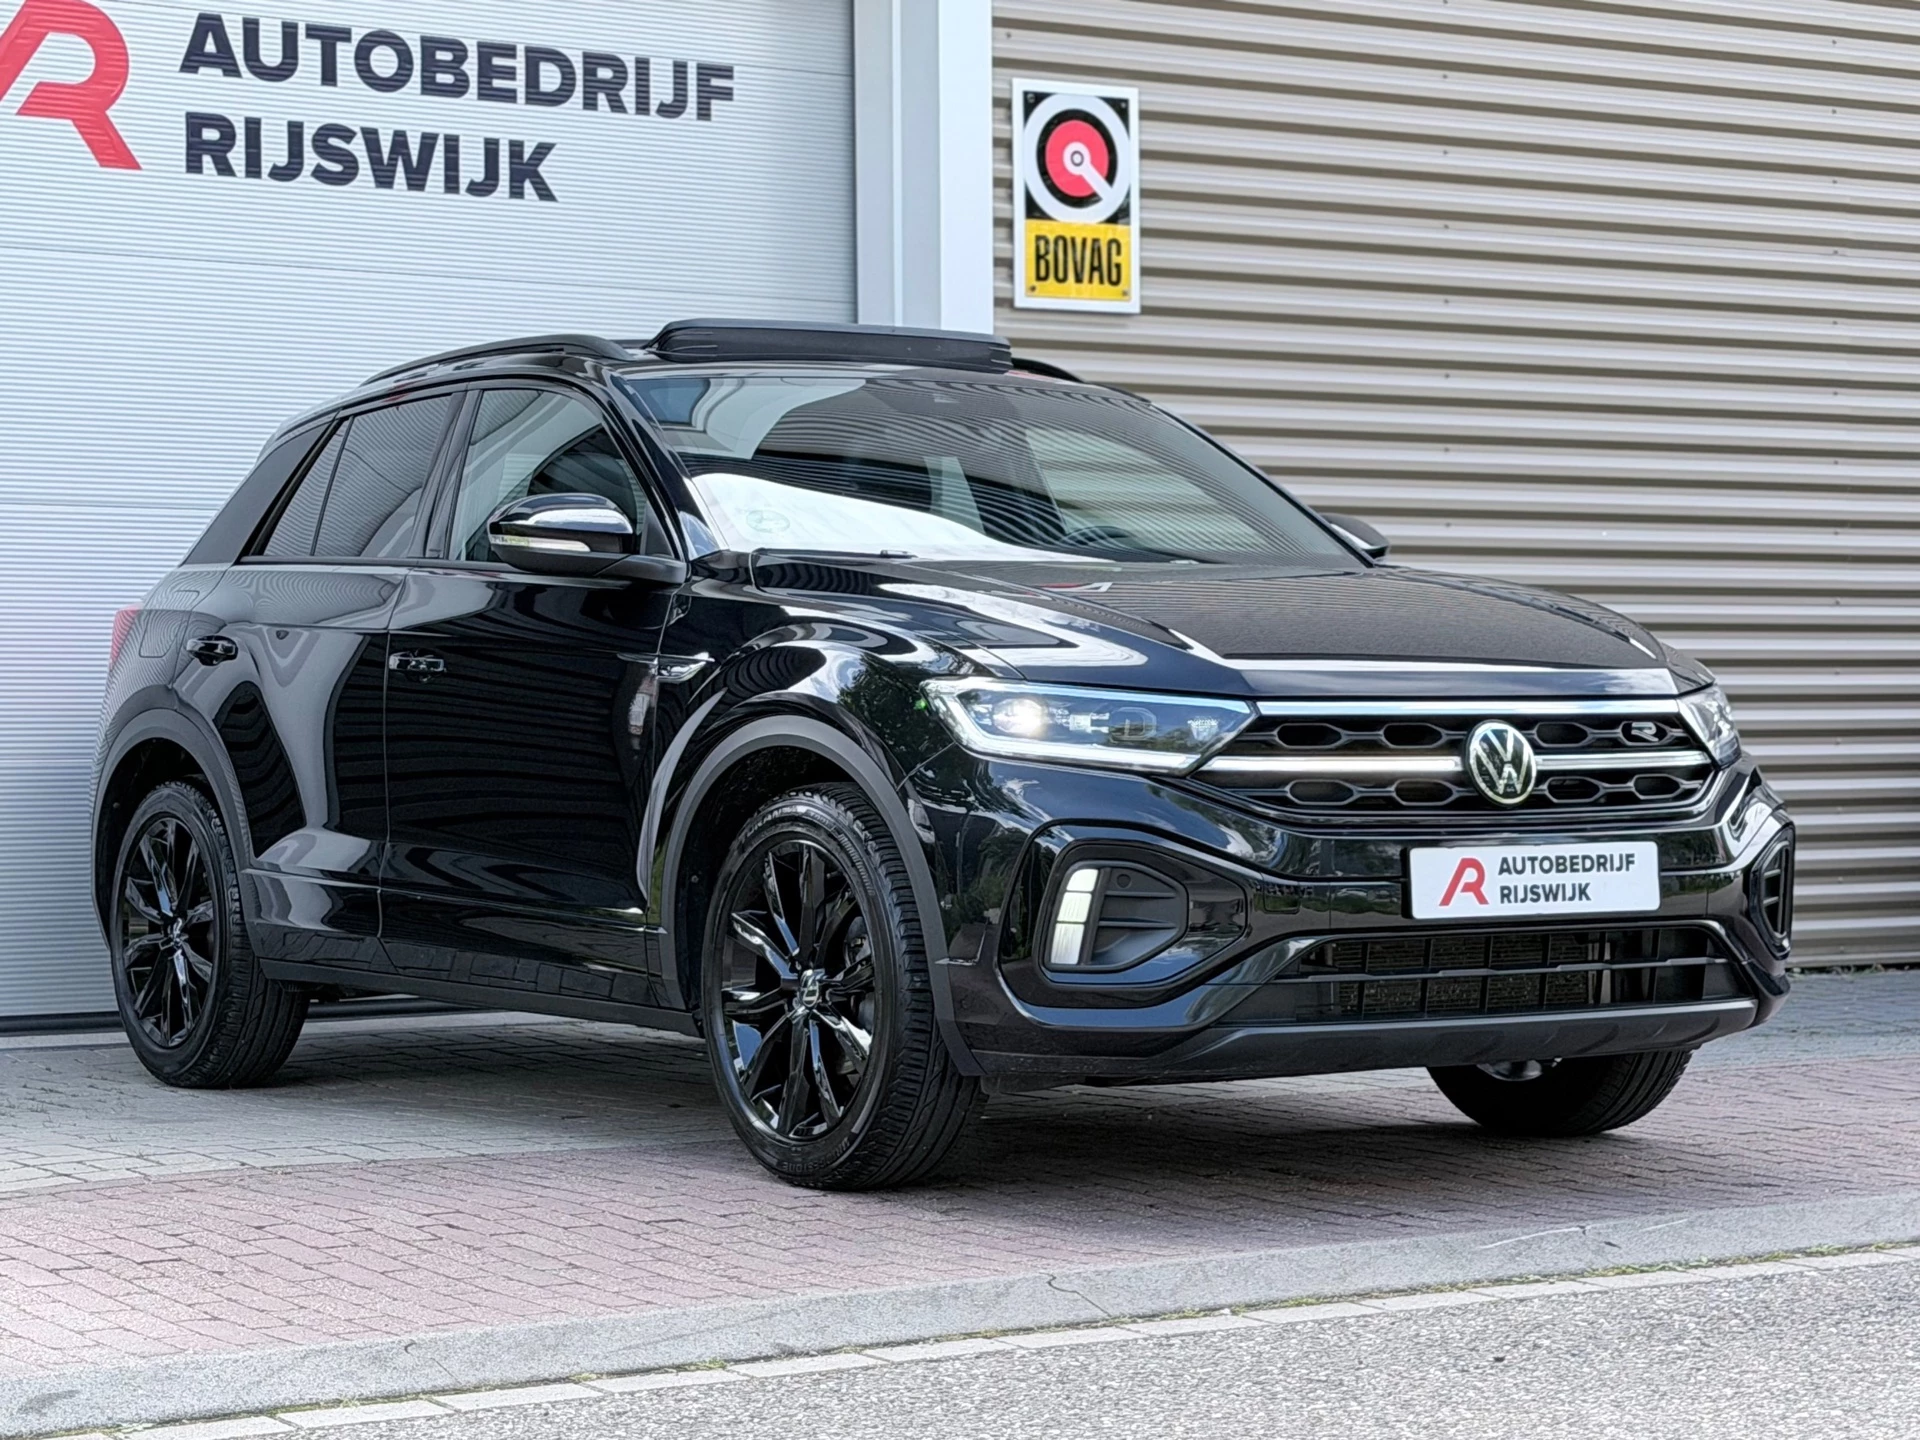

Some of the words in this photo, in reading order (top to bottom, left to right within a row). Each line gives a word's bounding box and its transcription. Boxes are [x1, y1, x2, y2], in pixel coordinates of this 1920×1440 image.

[179, 13, 735, 122] AUTOBEDRIJF
[185, 112, 559, 202] RIJSWIJK
[1035, 235, 1122, 286] BOVAG
[1498, 853, 1636, 876] AUTOBEDRIJF
[1499, 882, 1592, 904] RIJSWIJK
